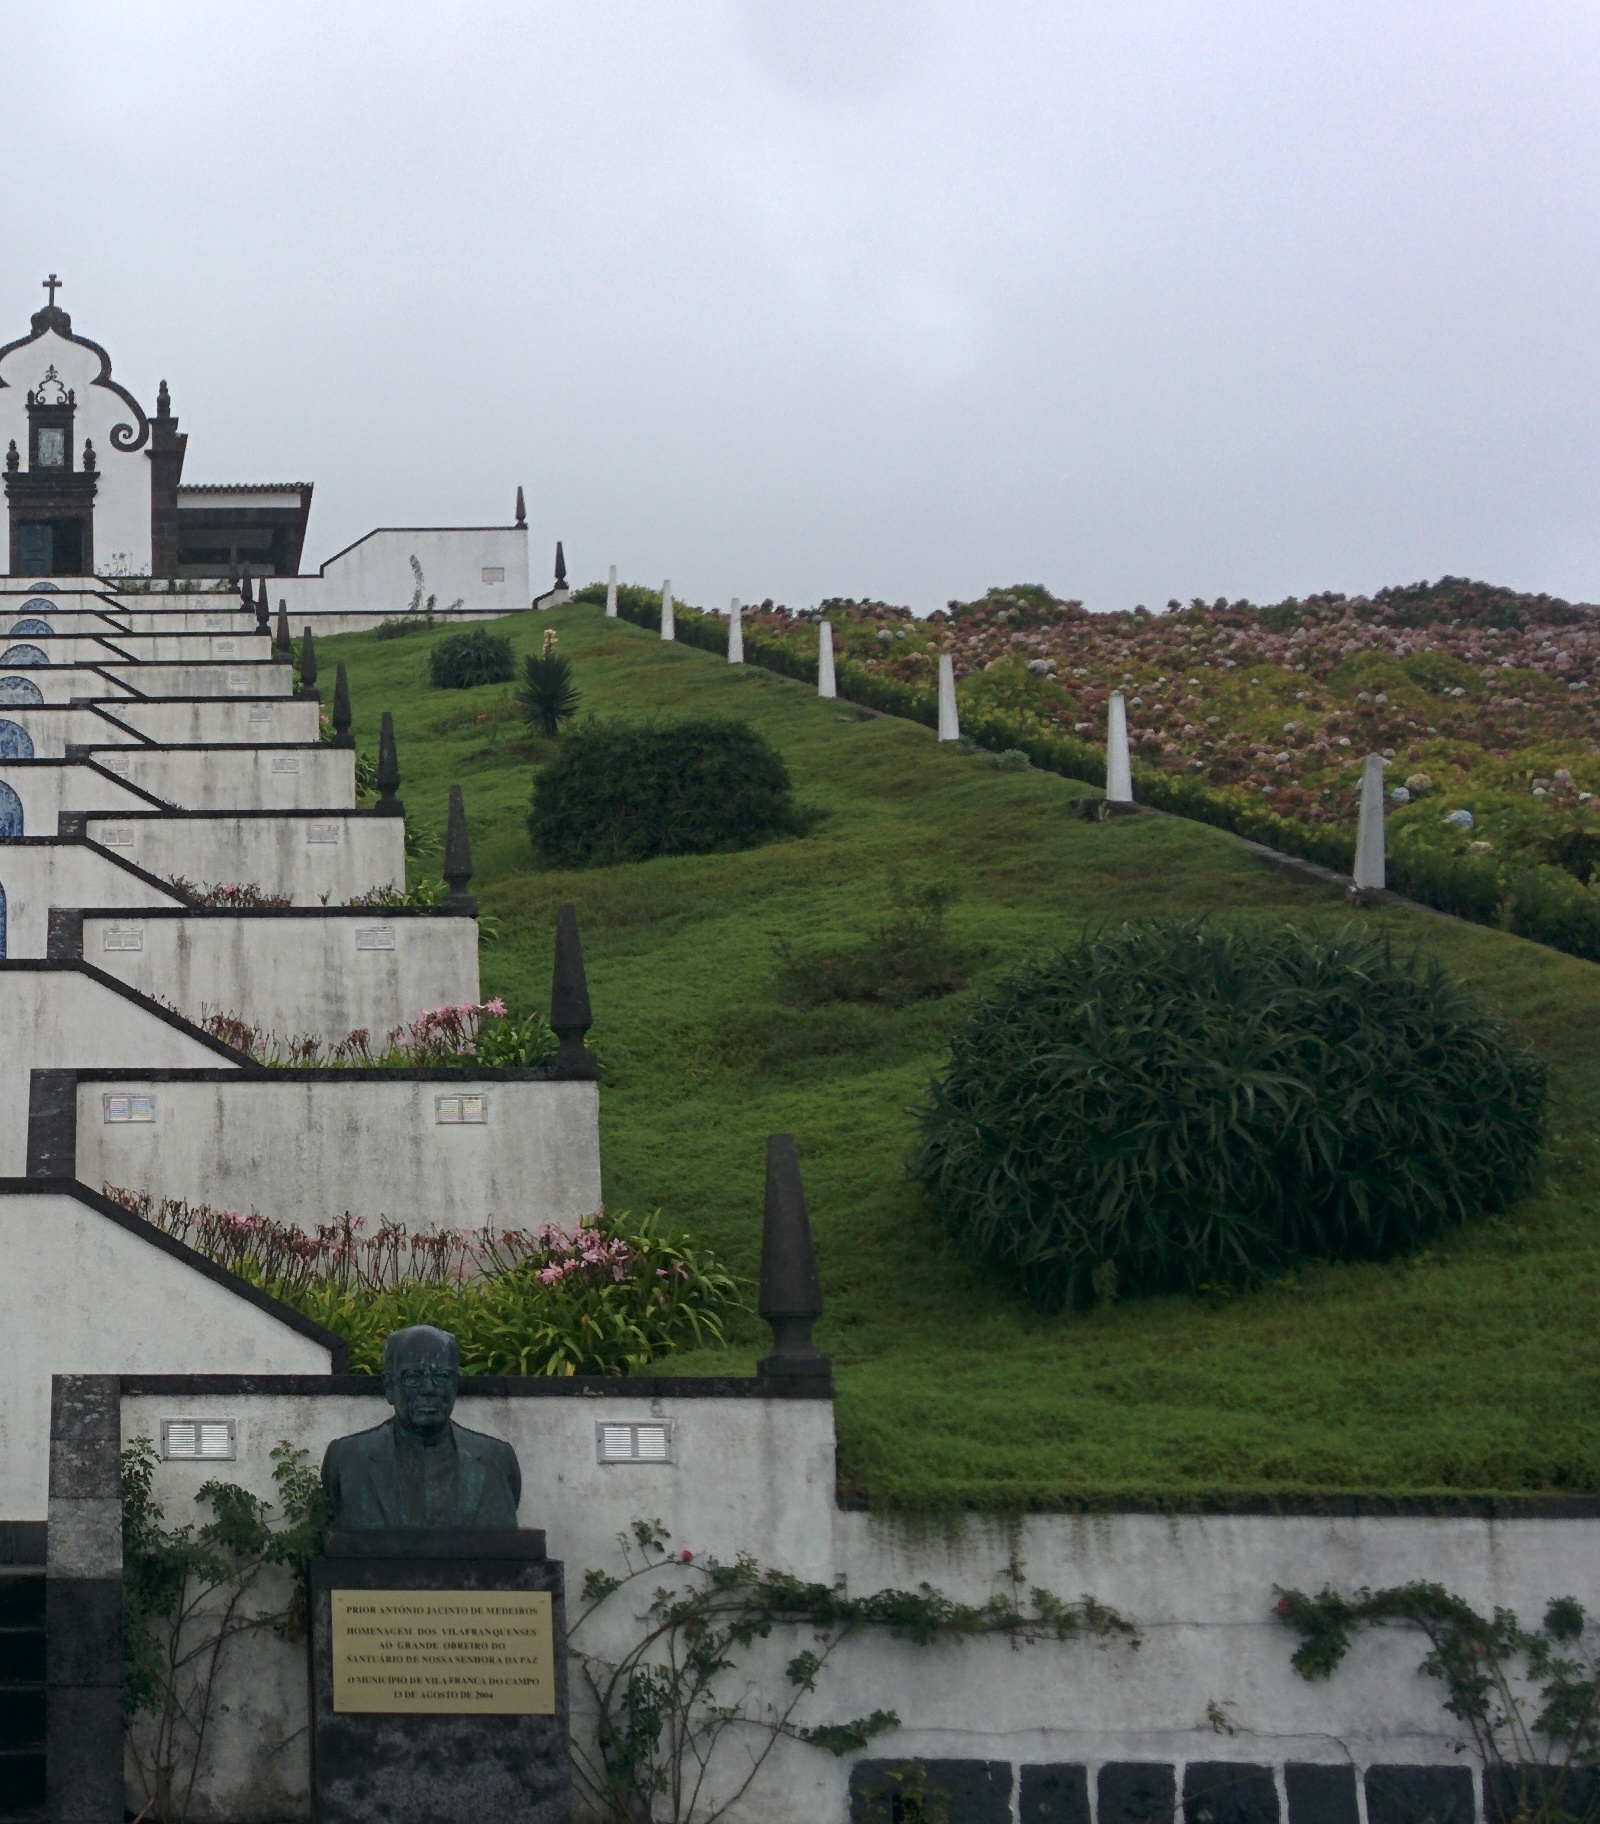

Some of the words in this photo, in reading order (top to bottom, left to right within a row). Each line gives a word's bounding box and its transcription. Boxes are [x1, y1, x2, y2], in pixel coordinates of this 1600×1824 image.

[346, 1606, 376, 1614] PRIOR
[380, 1605, 424, 1614] ANTÓNIO
[427, 1607, 468, 1615] JACINTO
[486, 1607, 538, 1615] MEDEIROS
[347, 1627, 412, 1635] HOMENAGEM
[442, 1628, 536, 1637] VILAFRANQUENSES
[443, 1642, 488, 1650] OBREIRO
[346, 1653, 404, 1663] SANTUÁRIO
[422, 1656, 453, 1664] NOSSA
[455, 1656, 502, 1664] SENHORA
[356, 1675, 407, 1684] MUNICÍPIO
